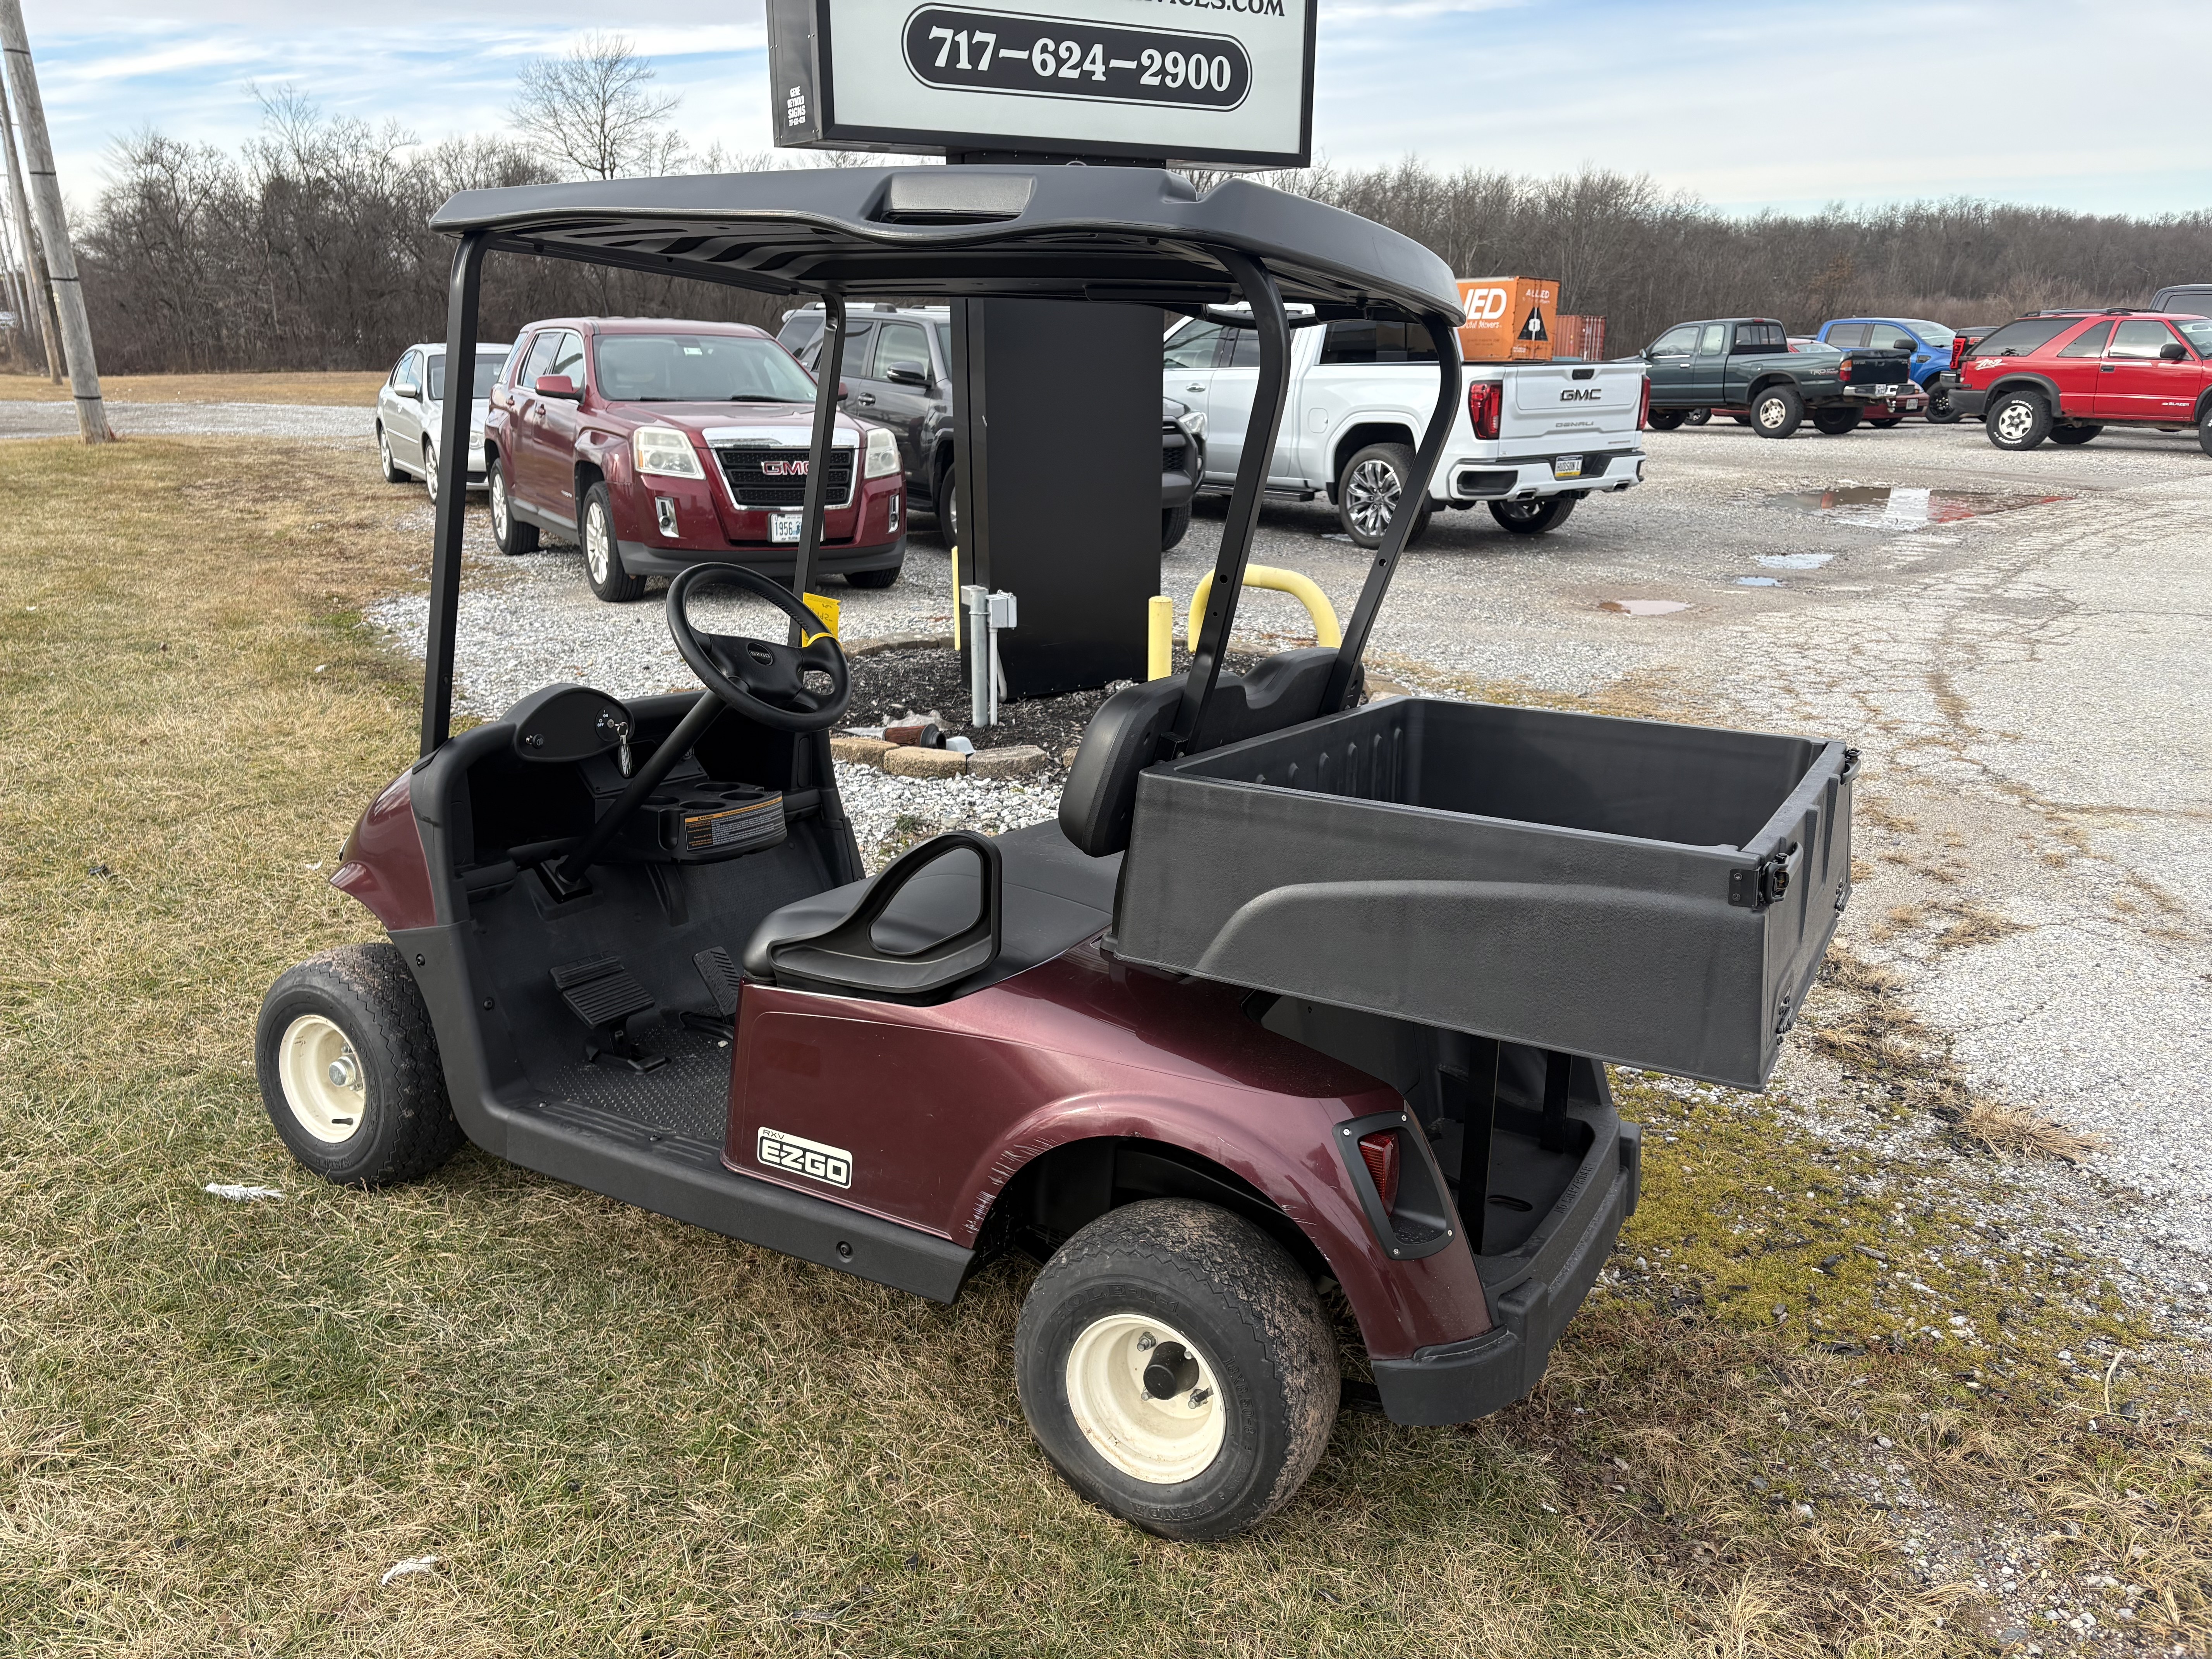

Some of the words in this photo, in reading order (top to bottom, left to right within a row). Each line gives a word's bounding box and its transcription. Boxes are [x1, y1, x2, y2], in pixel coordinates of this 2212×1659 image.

[928, 25, 1231, 92] 717-624-2900
[788, 105, 806, 119] SIGNS
[1560, 389, 1602, 401] GMC
[775, 521, 793, 536] 1956
[763, 1129, 785, 1140] RXV
[1554, 1204, 1568, 1214] NO
[1130, 1500, 1215, 1521] KENDA
